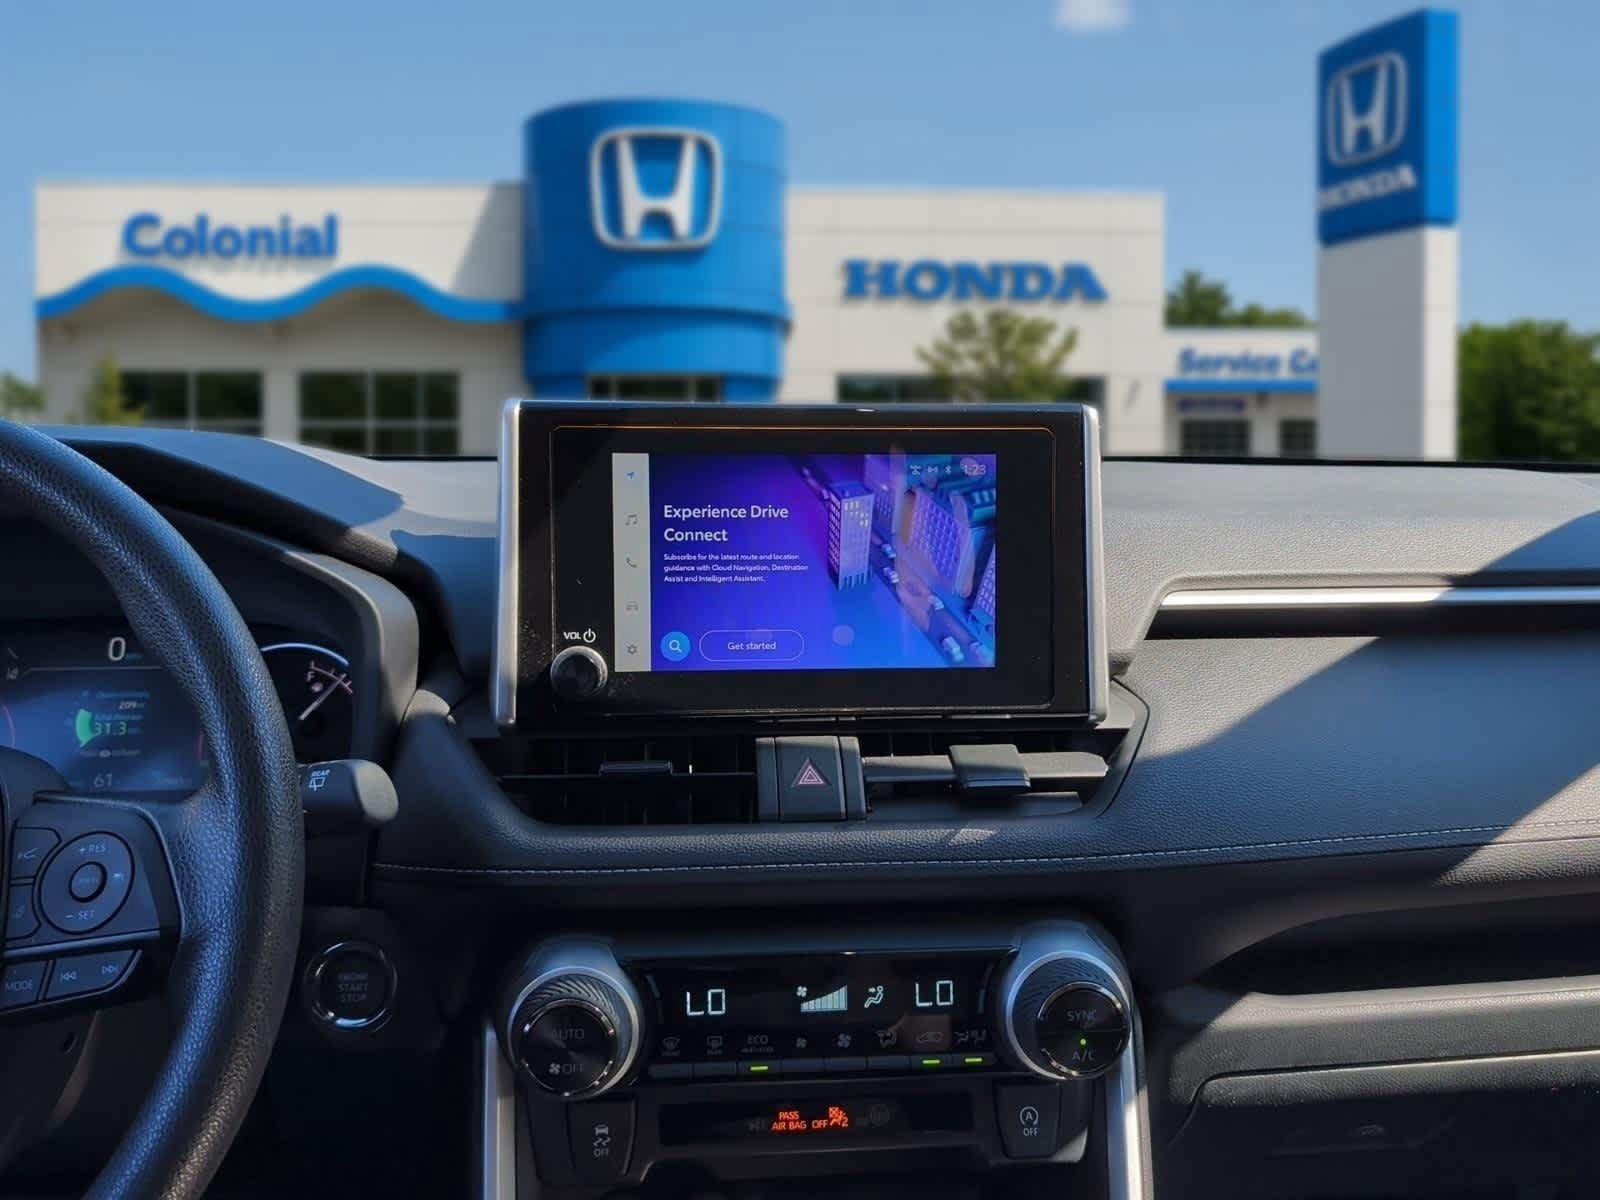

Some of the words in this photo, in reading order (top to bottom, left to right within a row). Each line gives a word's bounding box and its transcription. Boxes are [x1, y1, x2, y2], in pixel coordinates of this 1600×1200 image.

[121, 212, 338, 259] Colonial
[842, 259, 1107, 302] HONDA
[1179, 347, 1280, 375] Service
[663, 504, 747, 520] Experience
[750, 504, 789, 518] Drive
[663, 528, 728, 541] Connect
[773, 552, 800, 560] location
[663, 564, 695, 573] guidance
[711, 564, 732, 572] Cloud
[663, 575, 684, 583] Assist
[685, 575, 698, 583] and
[698, 575, 732, 583] Intelligent
[562, 631, 582, 641] VOL
[727, 641, 744, 650] Get
[746, 641, 777, 650] started
[552, 1027, 585, 1041] AUTO
[747, 1034, 769, 1045] ECO
[778, 1111, 800, 1121] PASS
[772, 1120, 787, 1131] AIR
[788, 1119, 807, 1130] BAG
[811, 1118, 829, 1129] OFF
[1023, 1127, 1039, 1137] OFF
